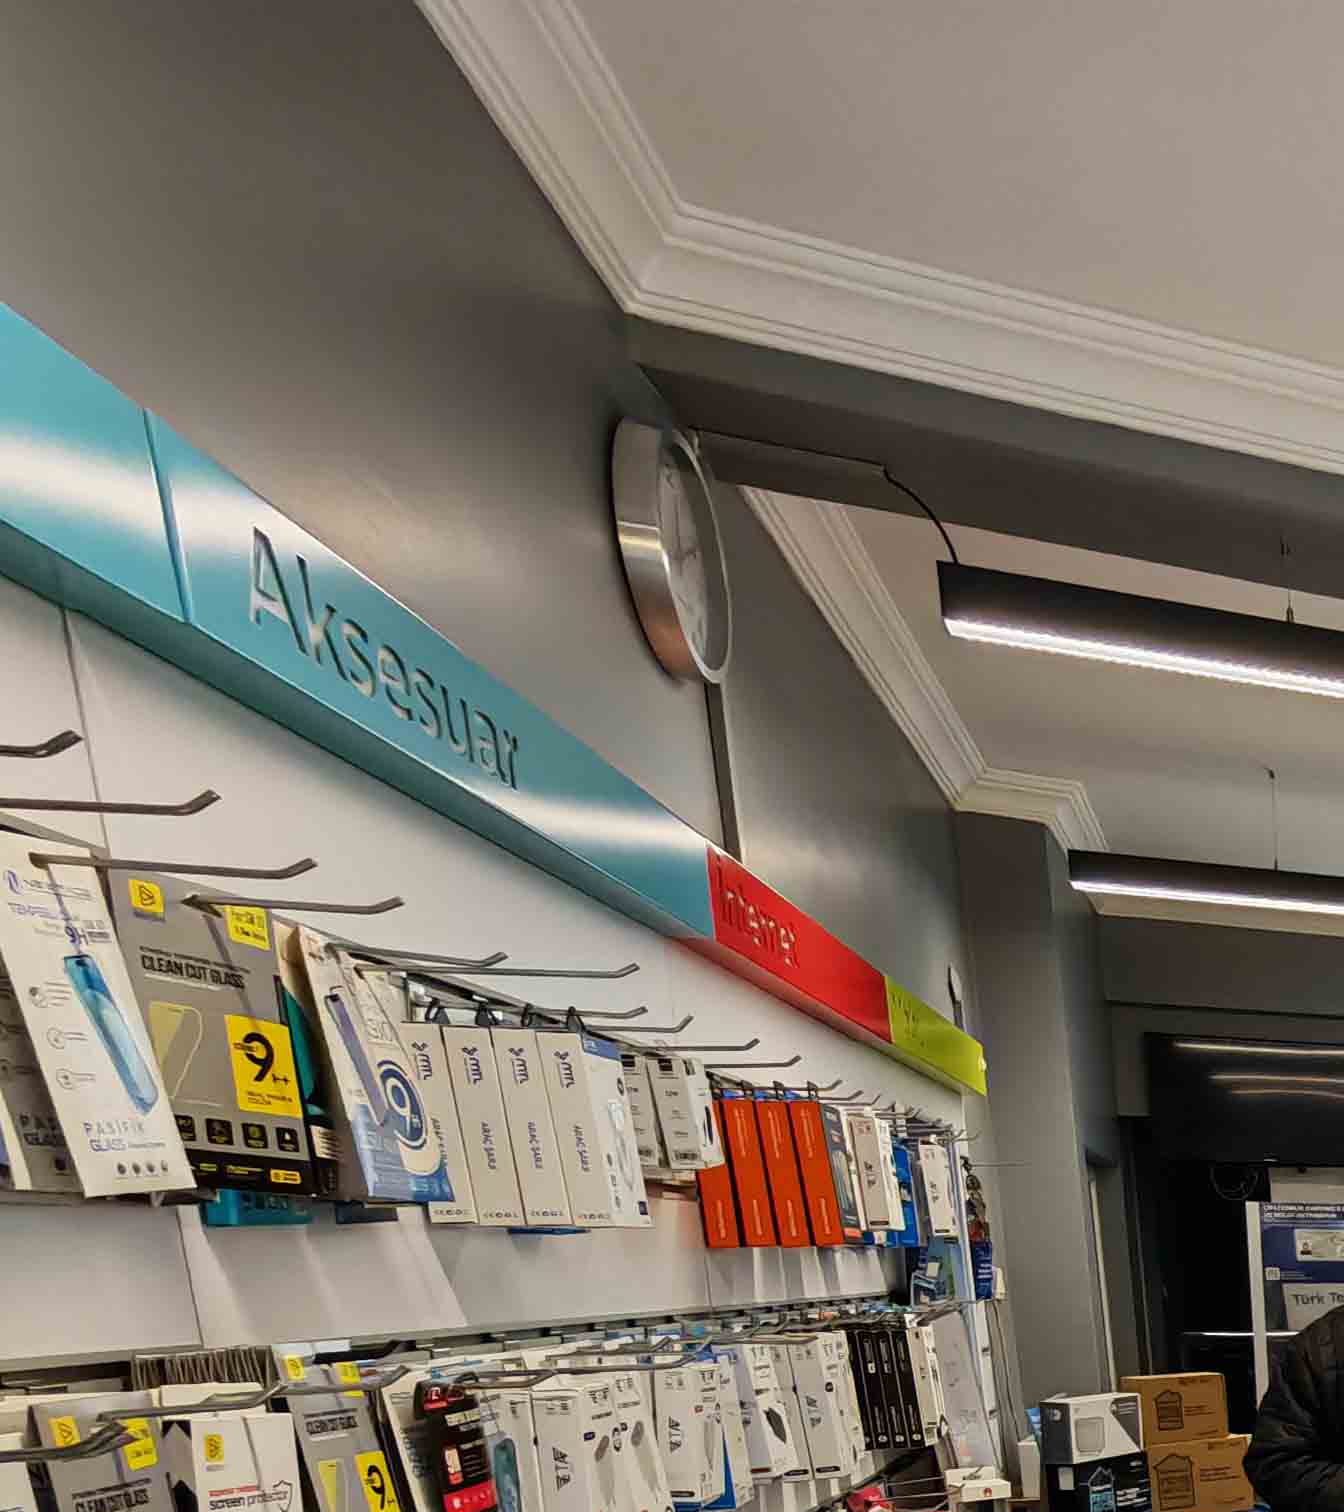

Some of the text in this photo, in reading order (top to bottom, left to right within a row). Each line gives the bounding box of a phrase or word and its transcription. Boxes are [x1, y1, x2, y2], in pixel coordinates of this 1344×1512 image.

[250, 527, 519, 789] Aksesuar
[141, 956, 184, 977] CLEAN
[1292, 1292, 1326, 1306] Türk
